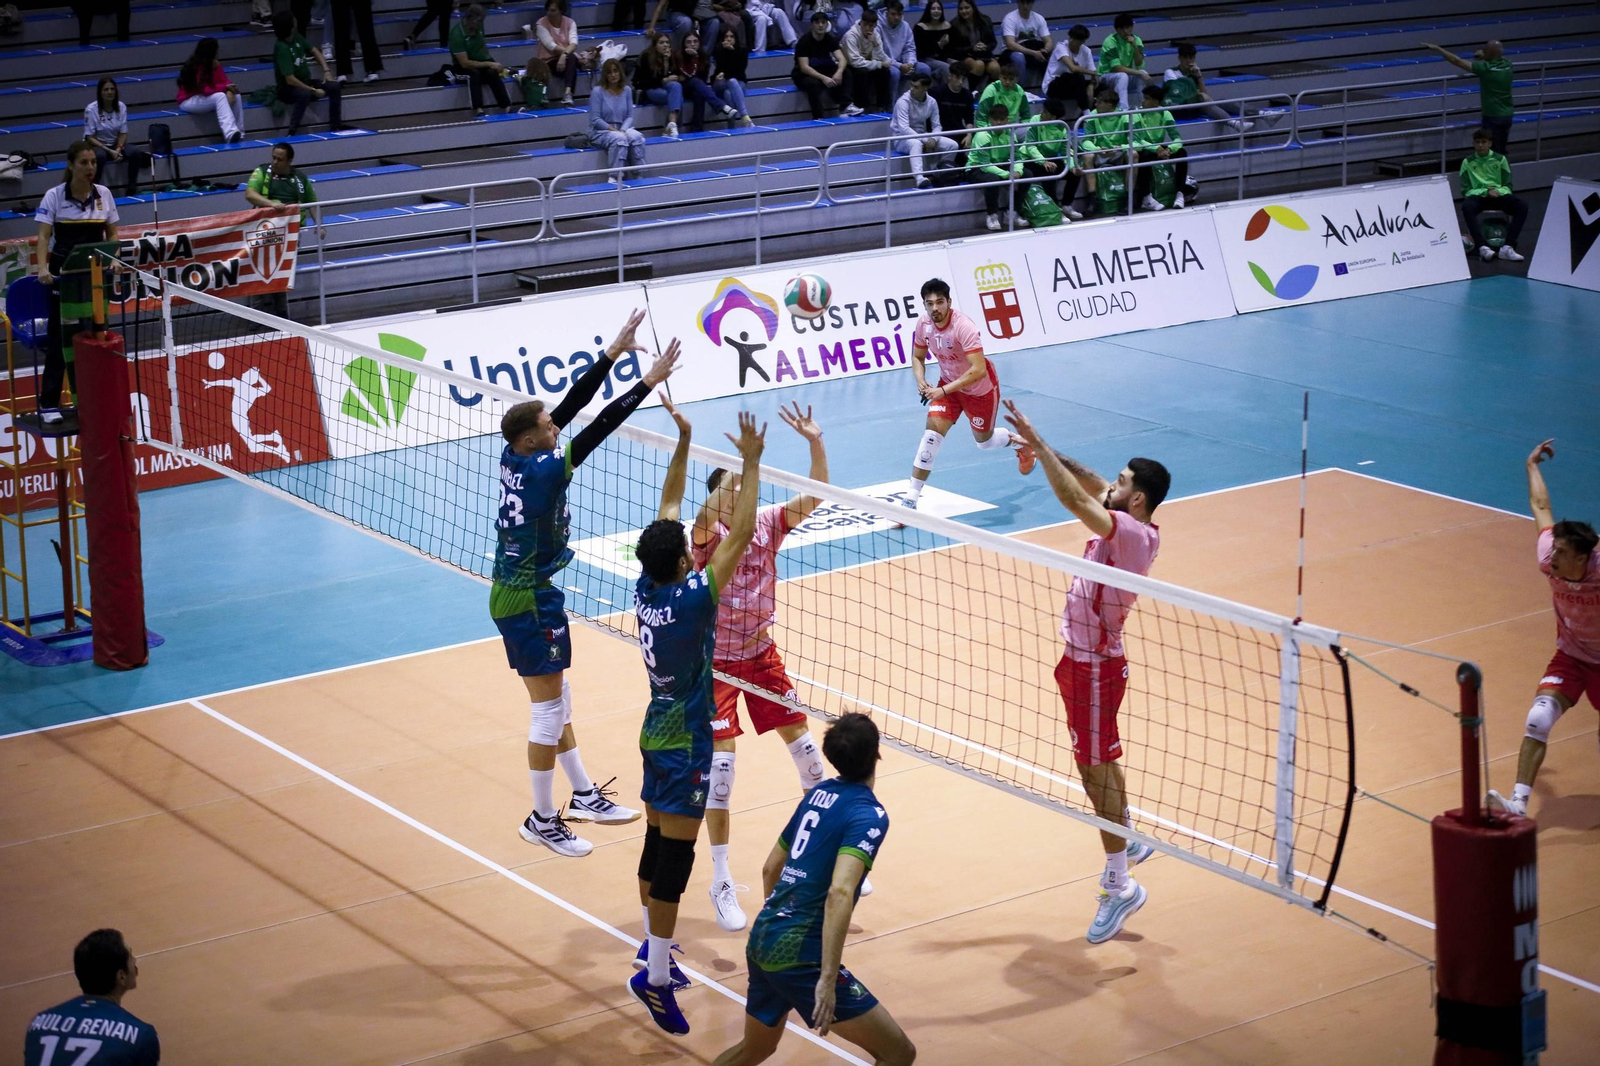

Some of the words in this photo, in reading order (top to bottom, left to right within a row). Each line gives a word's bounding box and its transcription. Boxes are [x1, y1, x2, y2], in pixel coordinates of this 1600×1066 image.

[1321, 199, 1435, 249] Andalucía
[119, 230, 194, 267] EÑA
[1053, 233, 1205, 292] ALMERÍA
[791, 301, 880, 334] COSTA
[884, 295, 919, 321] DE
[1057, 291, 1137, 321] CIUDAD
[444, 335, 643, 407] Unicaja
[776, 323, 931, 383] ALMERÍ
[639, 624, 656, 668] 8
[791, 809, 820, 860] 6
[28, 1013, 76, 1033] PAULO
[77, 1017, 139, 1045] RENAN
[39, 1034, 104, 1066] 17
